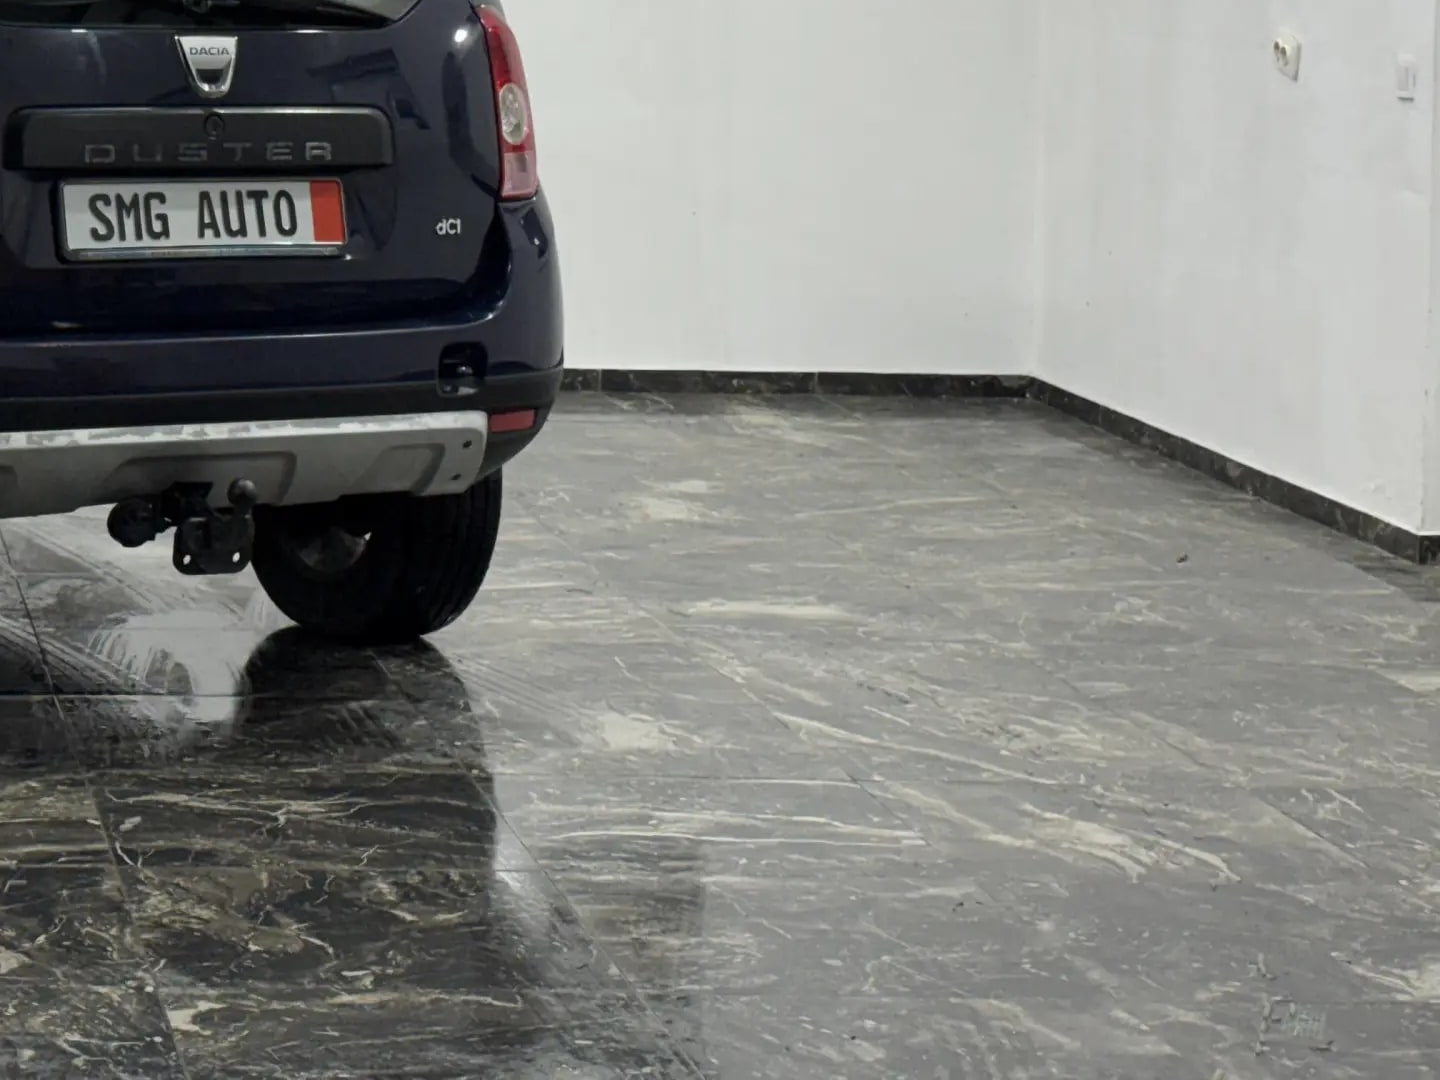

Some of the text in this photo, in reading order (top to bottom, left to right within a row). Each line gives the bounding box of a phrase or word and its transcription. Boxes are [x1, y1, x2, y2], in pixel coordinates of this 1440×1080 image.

[189, 46, 230, 56] DACIA
[84, 141, 332, 164] DUSTER
[87, 189, 298, 242] SMG AUTO
